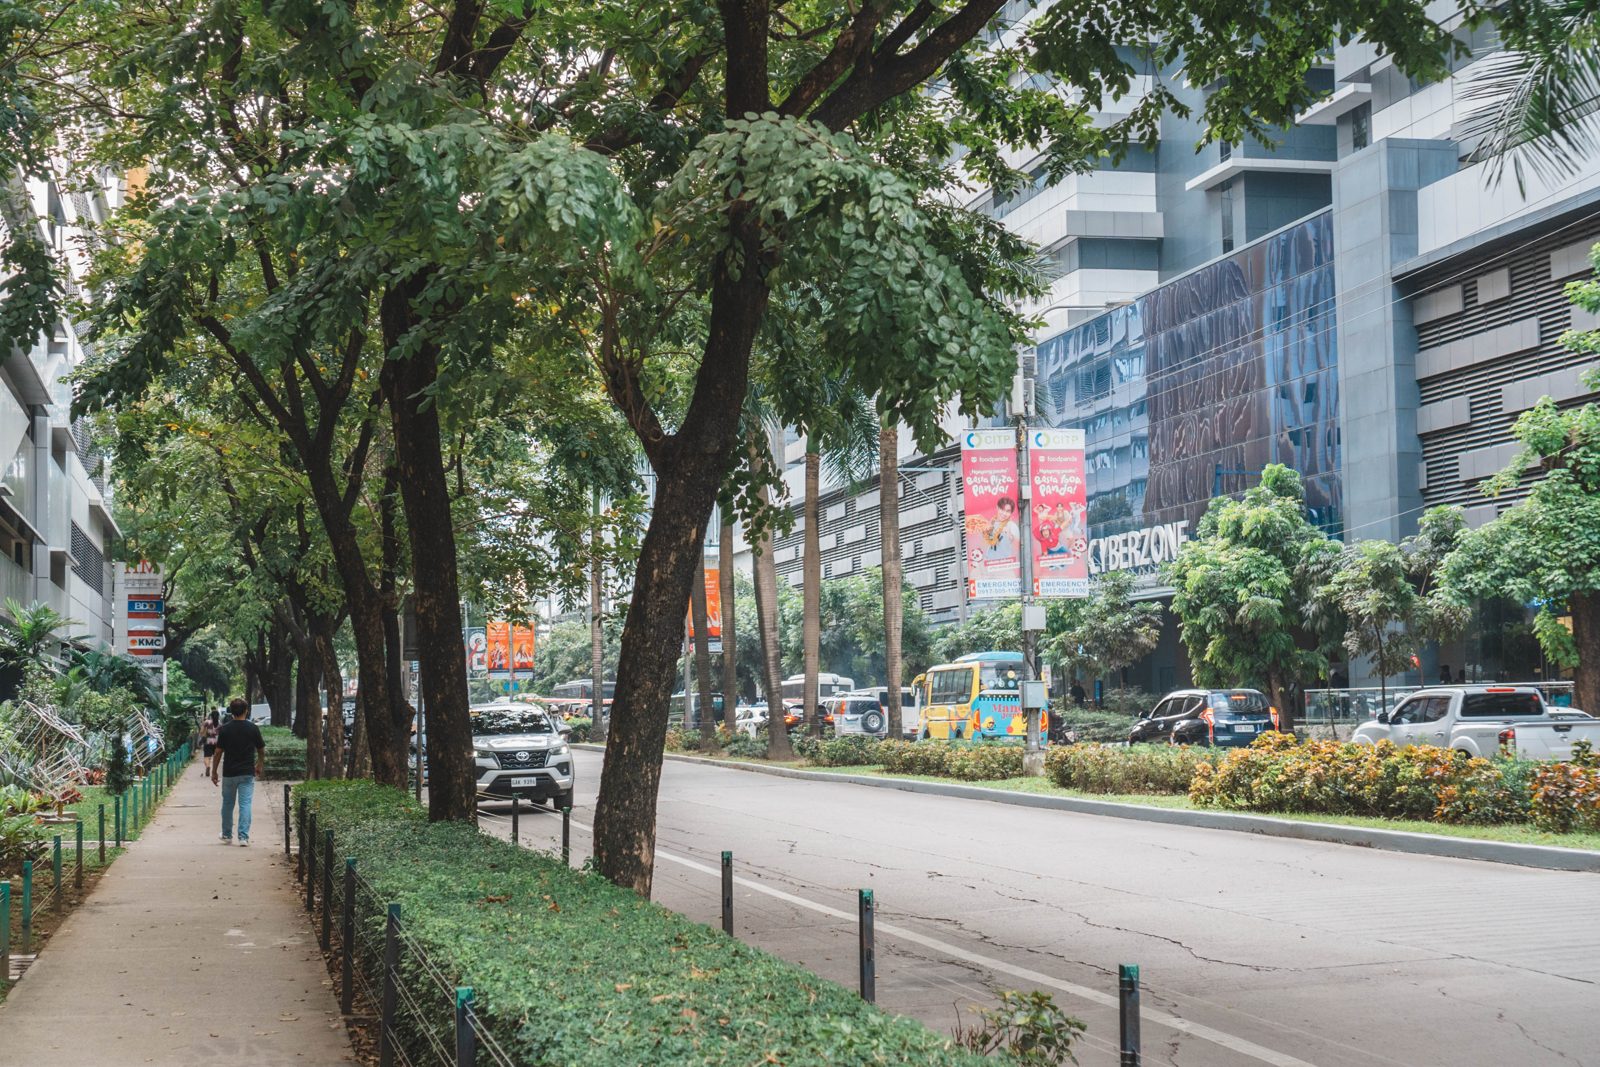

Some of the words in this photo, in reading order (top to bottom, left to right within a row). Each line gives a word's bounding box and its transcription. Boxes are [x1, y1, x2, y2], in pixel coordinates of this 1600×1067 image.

[1088, 520, 1190, 574] CYBERZONE
[977, 580, 1021, 588] EMERGENCY
[1041, 580, 1087, 588] EMERGENCY
[134, 602, 156, 610] BDO
[138, 638, 161, 647] KMC
